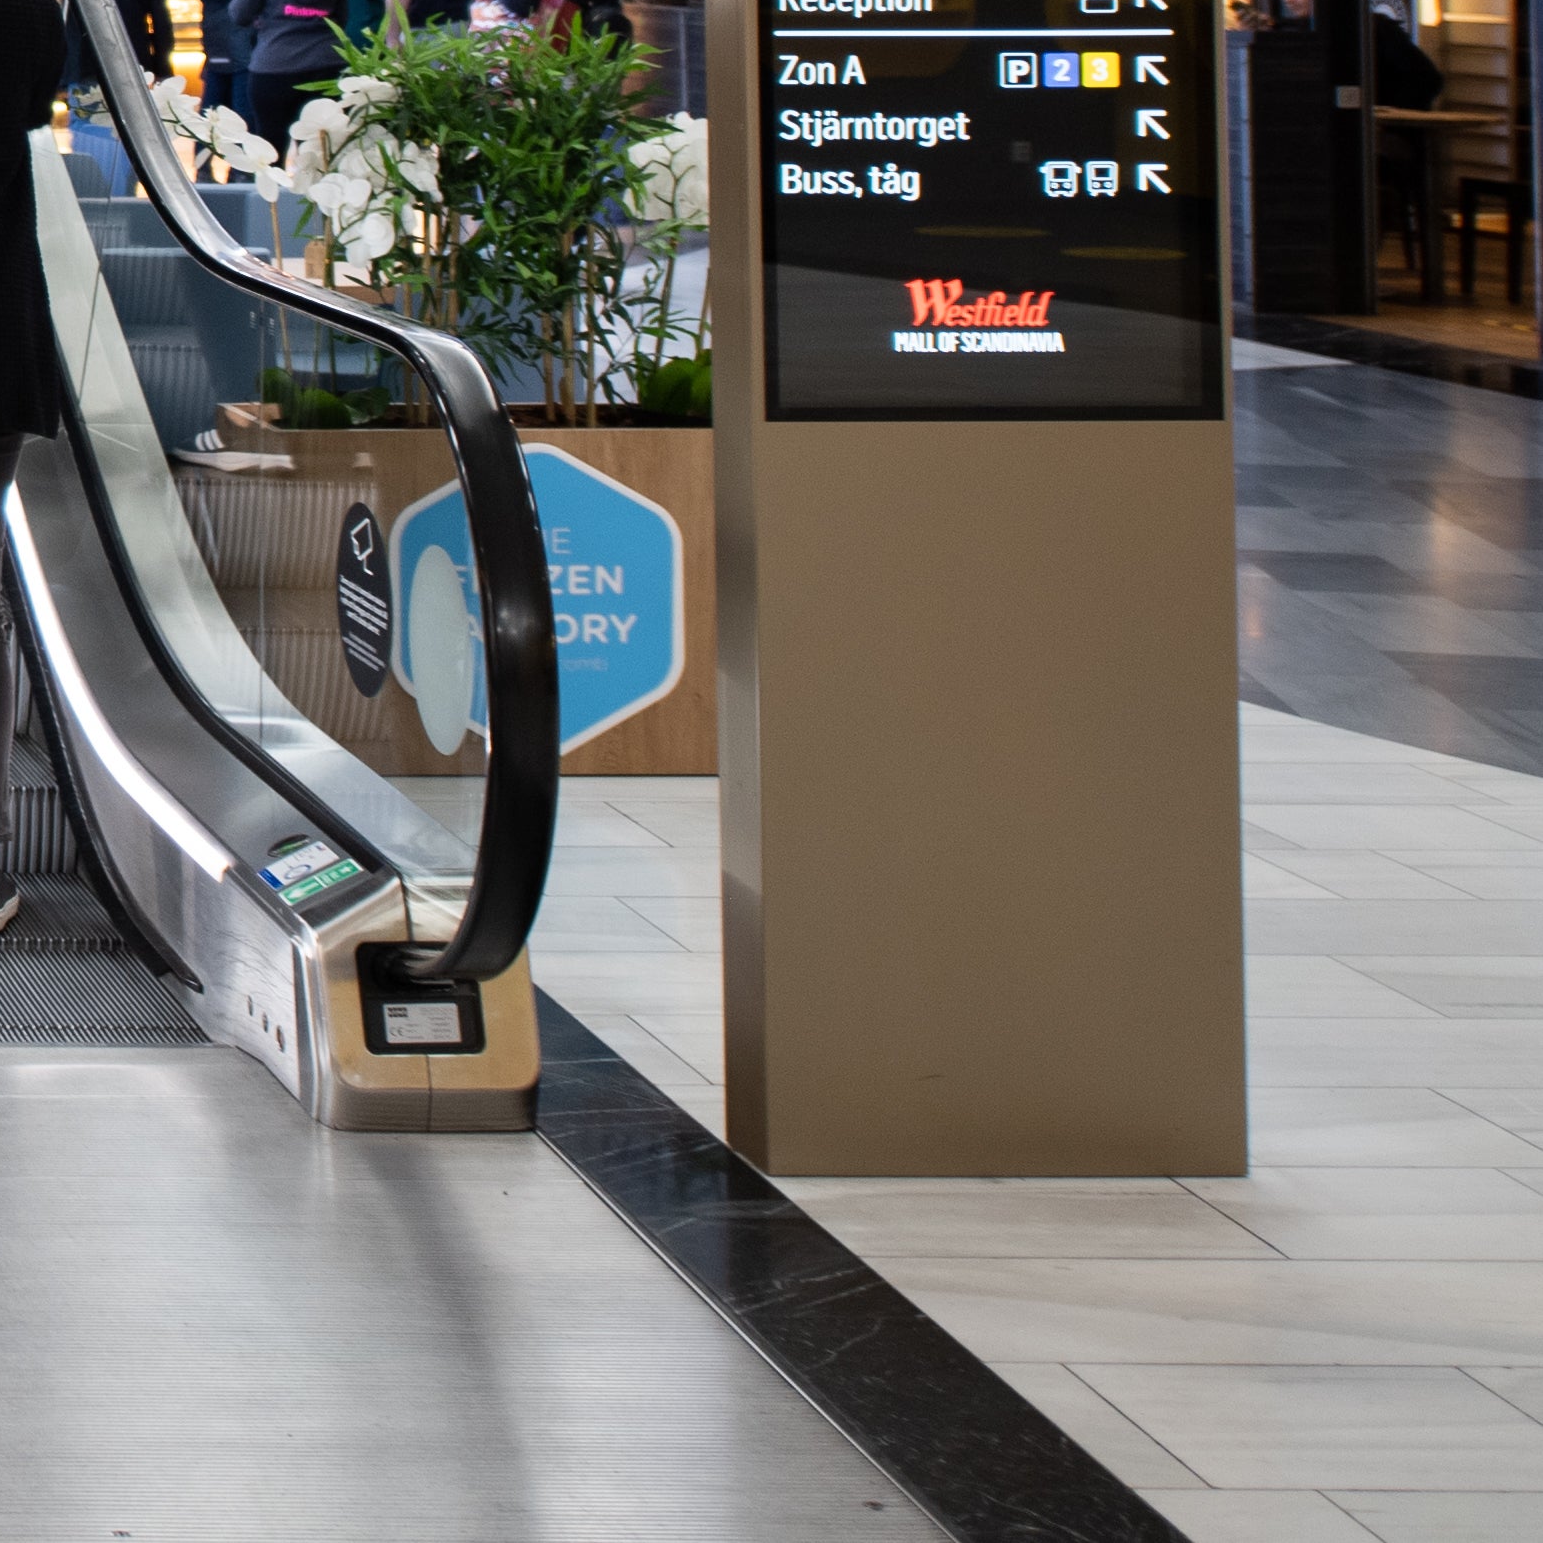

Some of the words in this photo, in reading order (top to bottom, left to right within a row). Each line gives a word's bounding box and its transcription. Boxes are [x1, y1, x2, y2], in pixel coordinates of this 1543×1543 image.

[778, 55, 836, 86] Zon
[841, 54, 867, 85] A
[1052, 58, 1071, 82] 2
[1090, 57, 1109, 83] 3
[779, 109, 971, 148] Stjärntorget
[781, 163, 863, 199] Buss,
[868, 163, 920, 201] tåg
[904, 278, 1055, 327] Westfield
[893, 332, 938, 353] MALL
[938, 332, 960, 353] OF
[959, 332, 1065, 353] SCANDINAVIA
